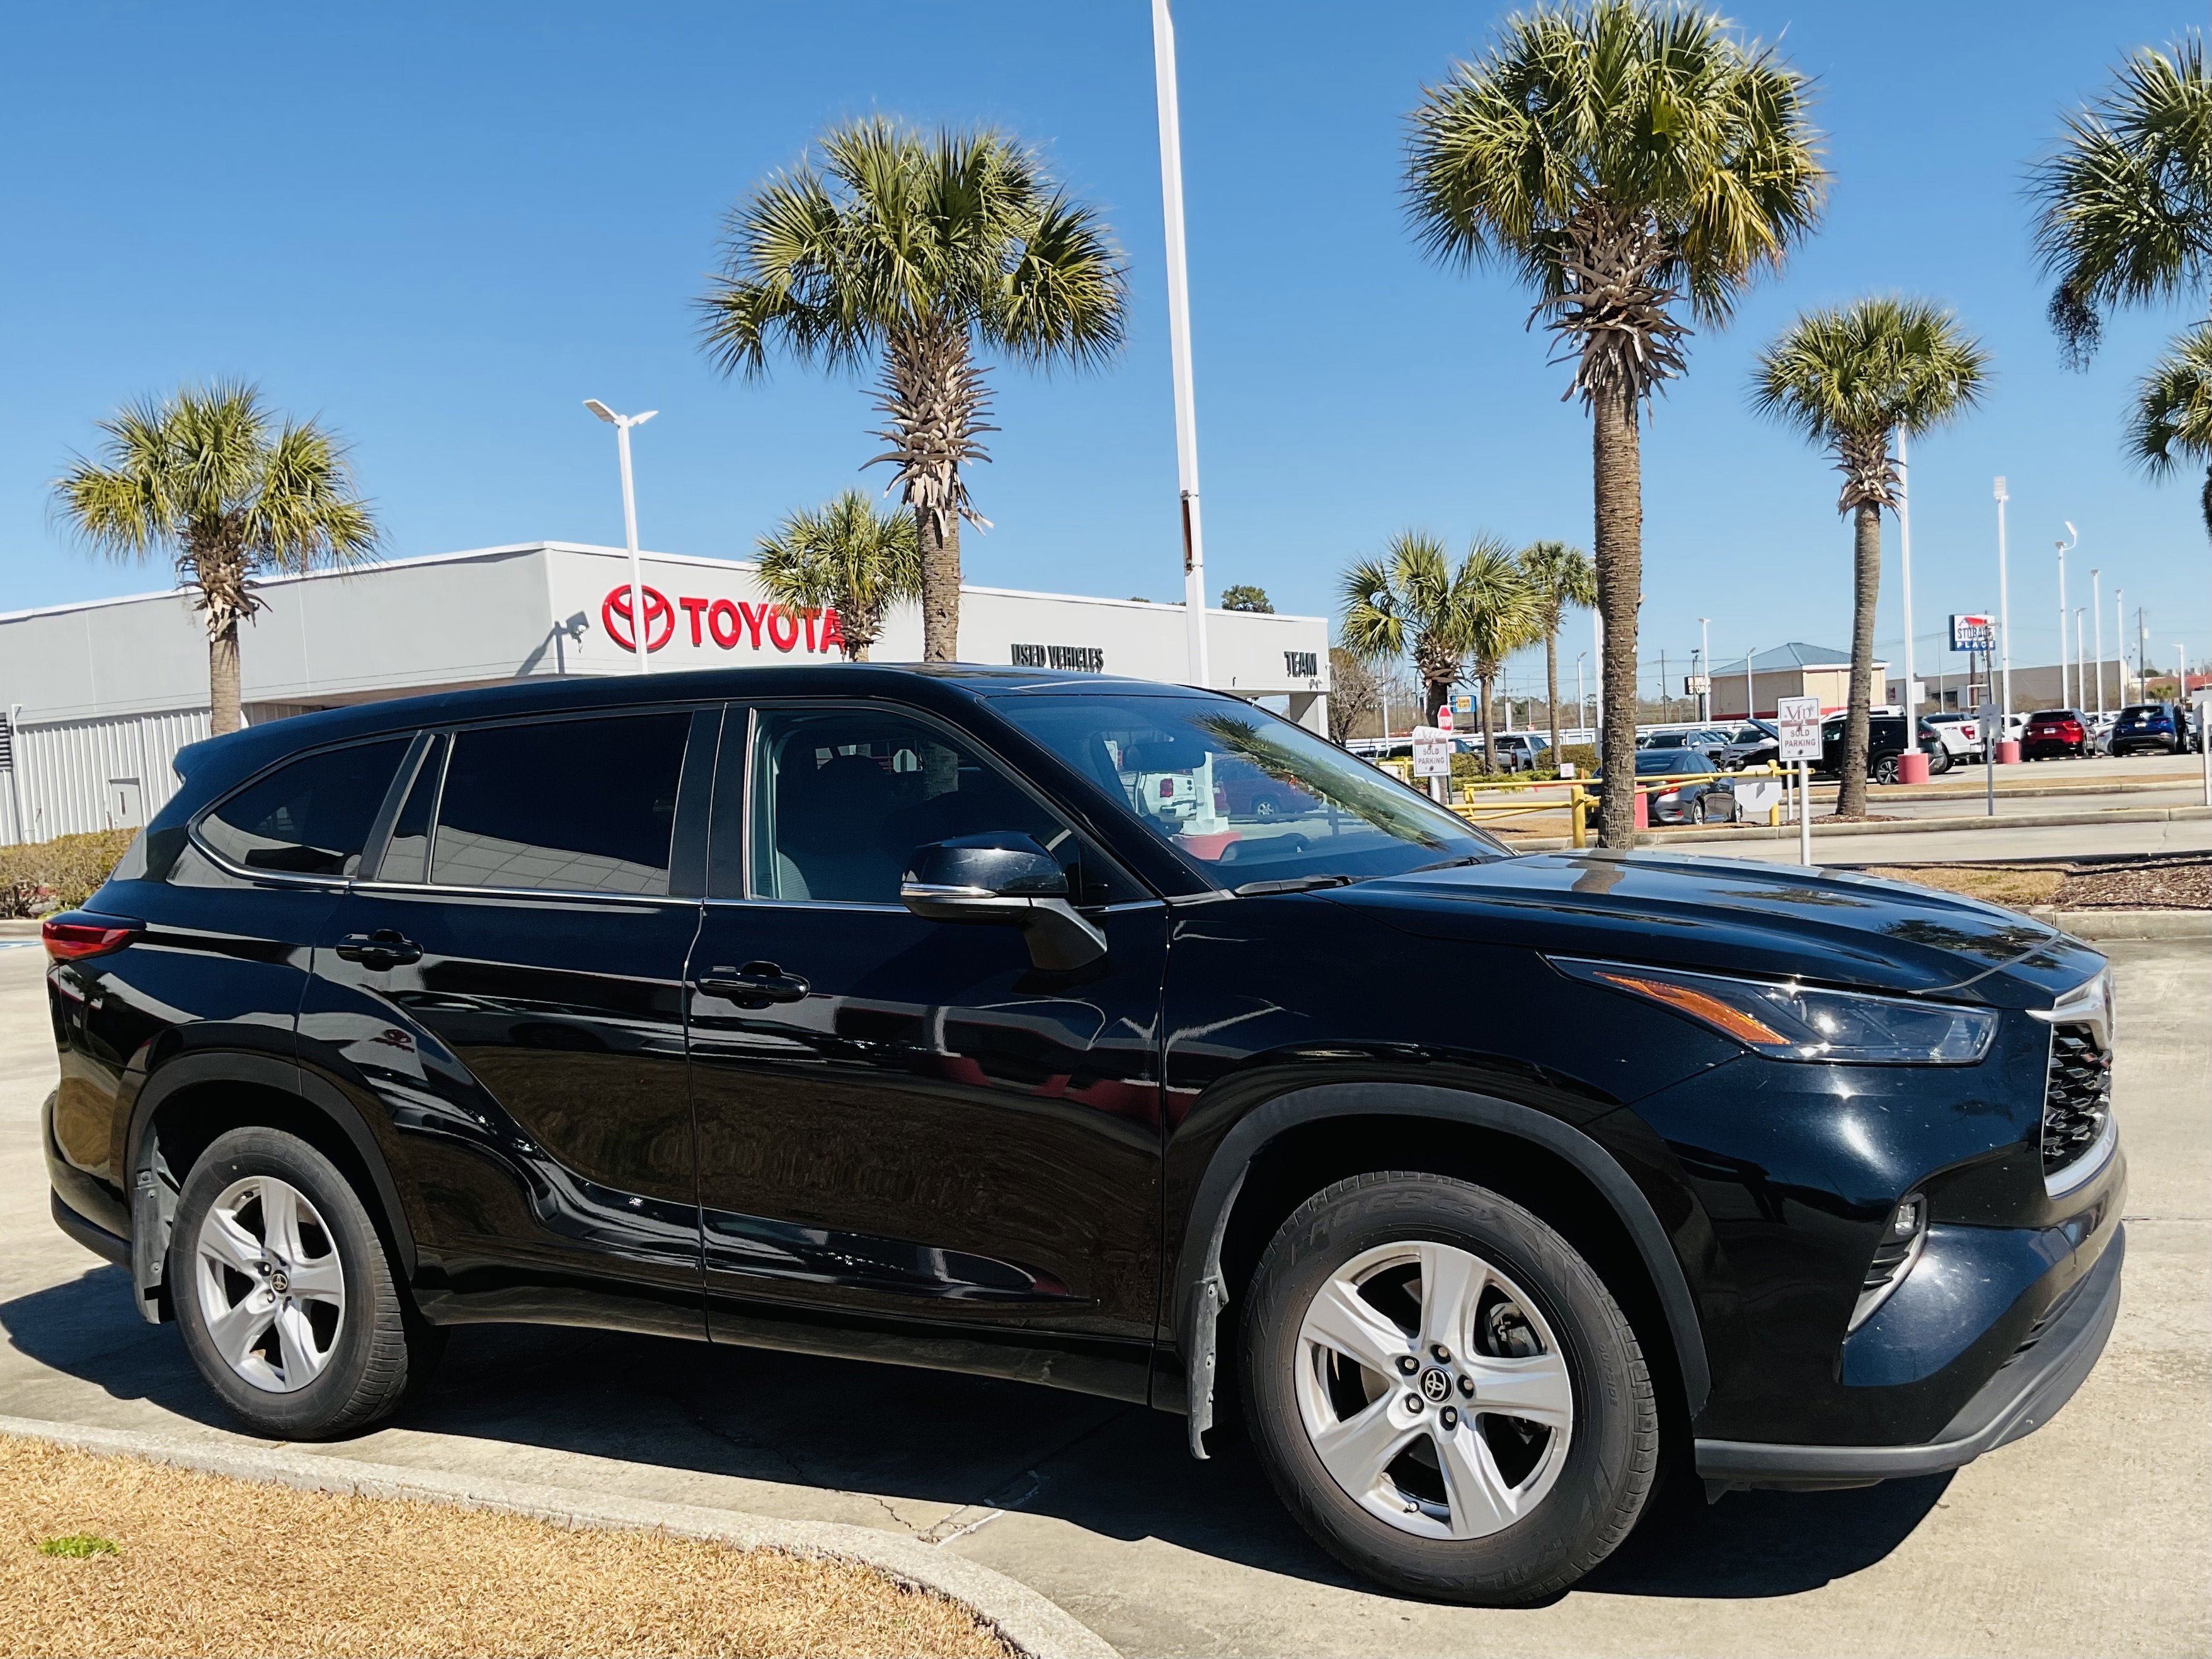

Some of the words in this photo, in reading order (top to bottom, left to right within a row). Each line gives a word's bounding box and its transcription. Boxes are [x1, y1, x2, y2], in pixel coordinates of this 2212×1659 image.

[679, 597, 845, 653] TOYOTA
[1011, 644, 1046, 667] USED
[1047, 645, 1104, 671] VEHICLES
[1284, 652, 1317, 677] TEAM
[1438, 716, 1452, 728] STOP
